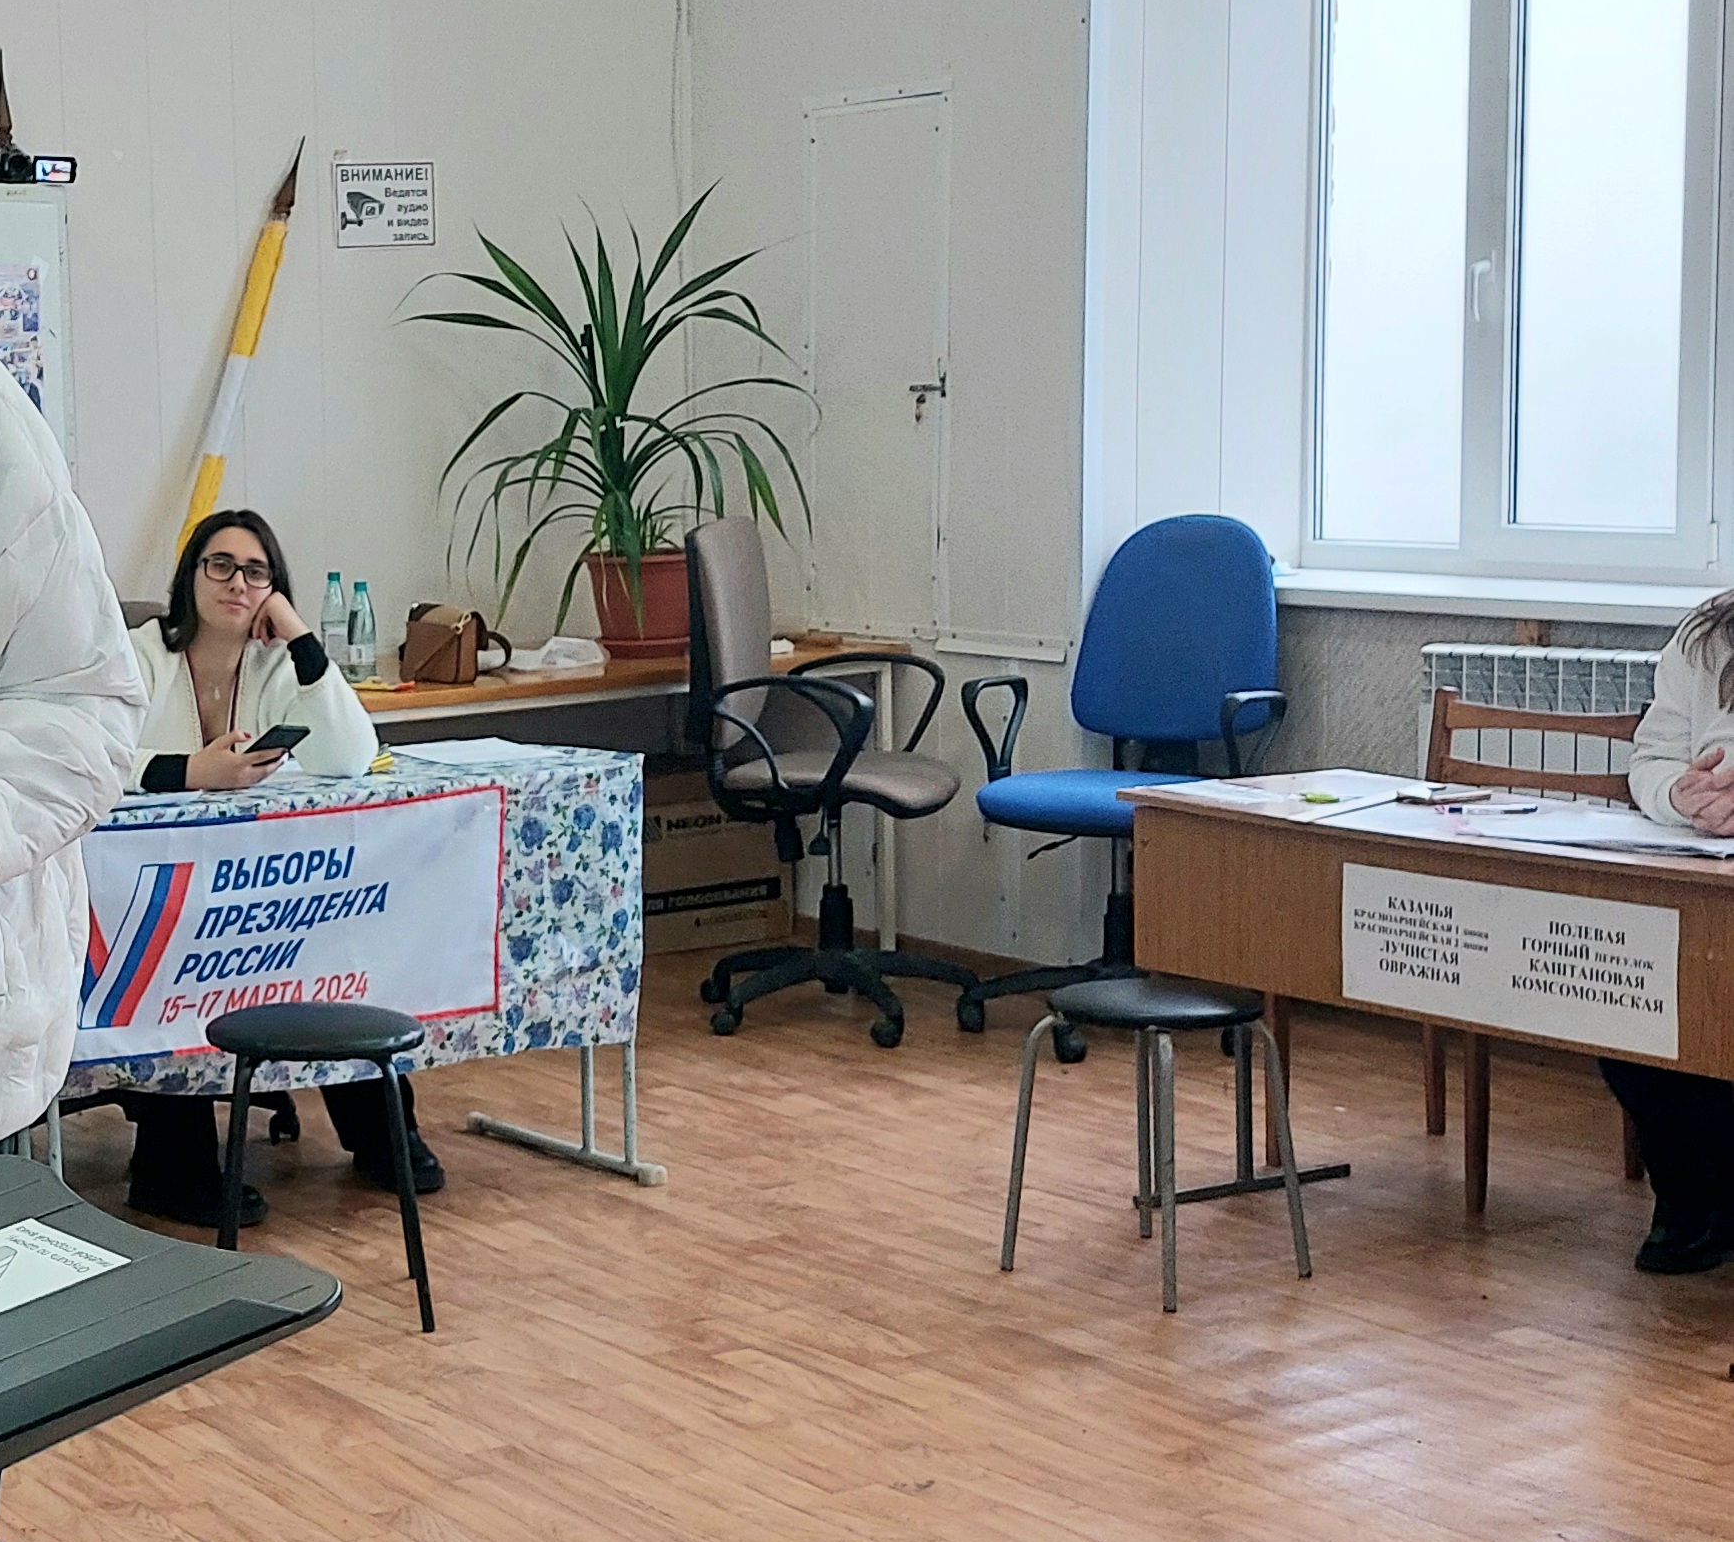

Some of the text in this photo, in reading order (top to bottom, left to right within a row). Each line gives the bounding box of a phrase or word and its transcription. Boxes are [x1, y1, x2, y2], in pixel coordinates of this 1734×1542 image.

[340, 167, 428, 182] ВНИМАНИЕ!
[397, 203, 428, 214] аудио
[387, 219, 394, 227] и
[211, 845, 355, 893] ВЫБОРЫ
[194, 881, 390, 940] ПРЕЗИДЕНТА
[1353, 908, 1453, 933] КРАСНОАРМЕЙСКАЯ
[1388, 896, 1453, 919] КАЗАЧЬЯ
[1353, 920, 1453, 946] КРАСНОАРМЕЙСКАЯ
[1549, 920, 1626, 946] ПОЛЕВАЯ
[173, 937, 306, 985] РОССИИ
[1379, 940, 1459, 966] ЛУЧИСТАЯ
[1522, 936, 1590, 960] ГОРНЫЙ
[1379, 958, 1460, 985] ОВРАЖНАЯ
[1529, 958, 1645, 991] КАШТАНОВАЯ
[224, 979, 303, 1015] МАРТА
[312, 971, 369, 1003] 2024
[1511, 974, 1664, 1015] КОМСОМОЛЬСКАЯ
